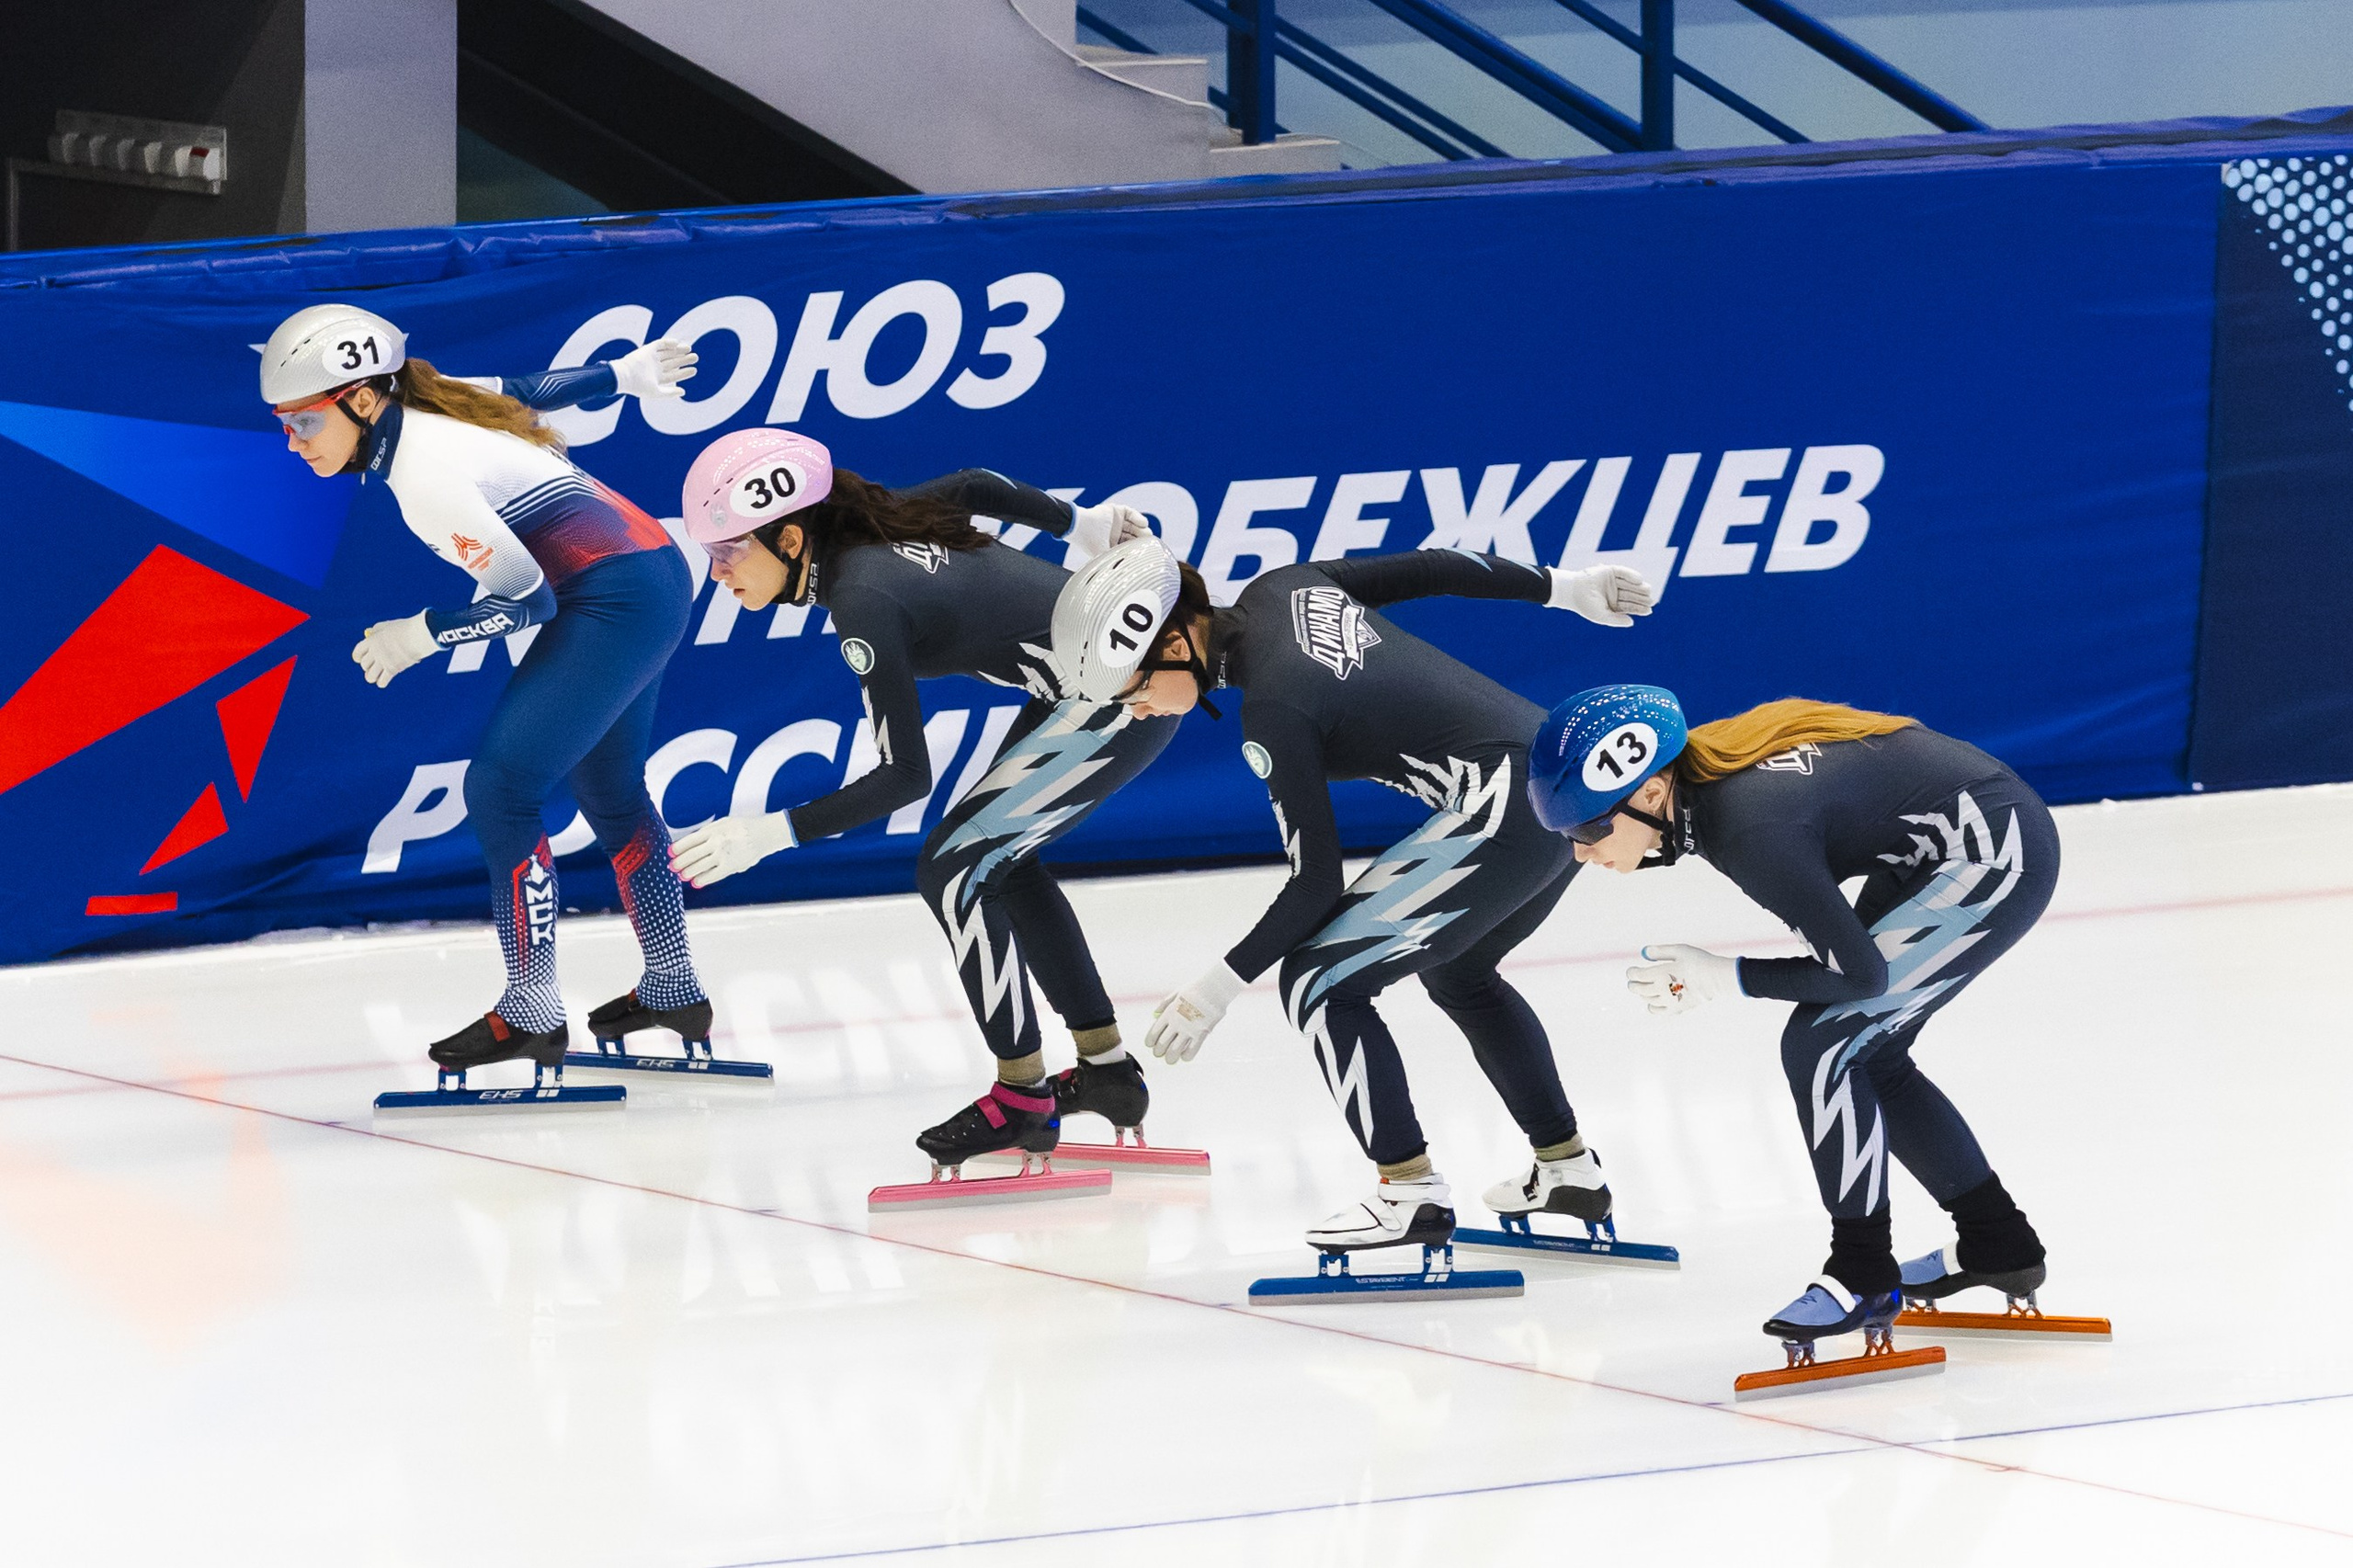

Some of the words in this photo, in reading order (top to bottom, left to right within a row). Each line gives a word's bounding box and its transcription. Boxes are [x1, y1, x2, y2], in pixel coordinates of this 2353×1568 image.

[336, 335, 380, 370] 31
[538, 271, 1066, 447] СОЮЗ
[744, 467, 796, 509] 30
[1109, 603, 1154, 652] 10
[1308, 588, 1346, 676] ДИНАМО
[1596, 732, 1647, 778] 13
[479, 1088, 524, 1100] EHS
